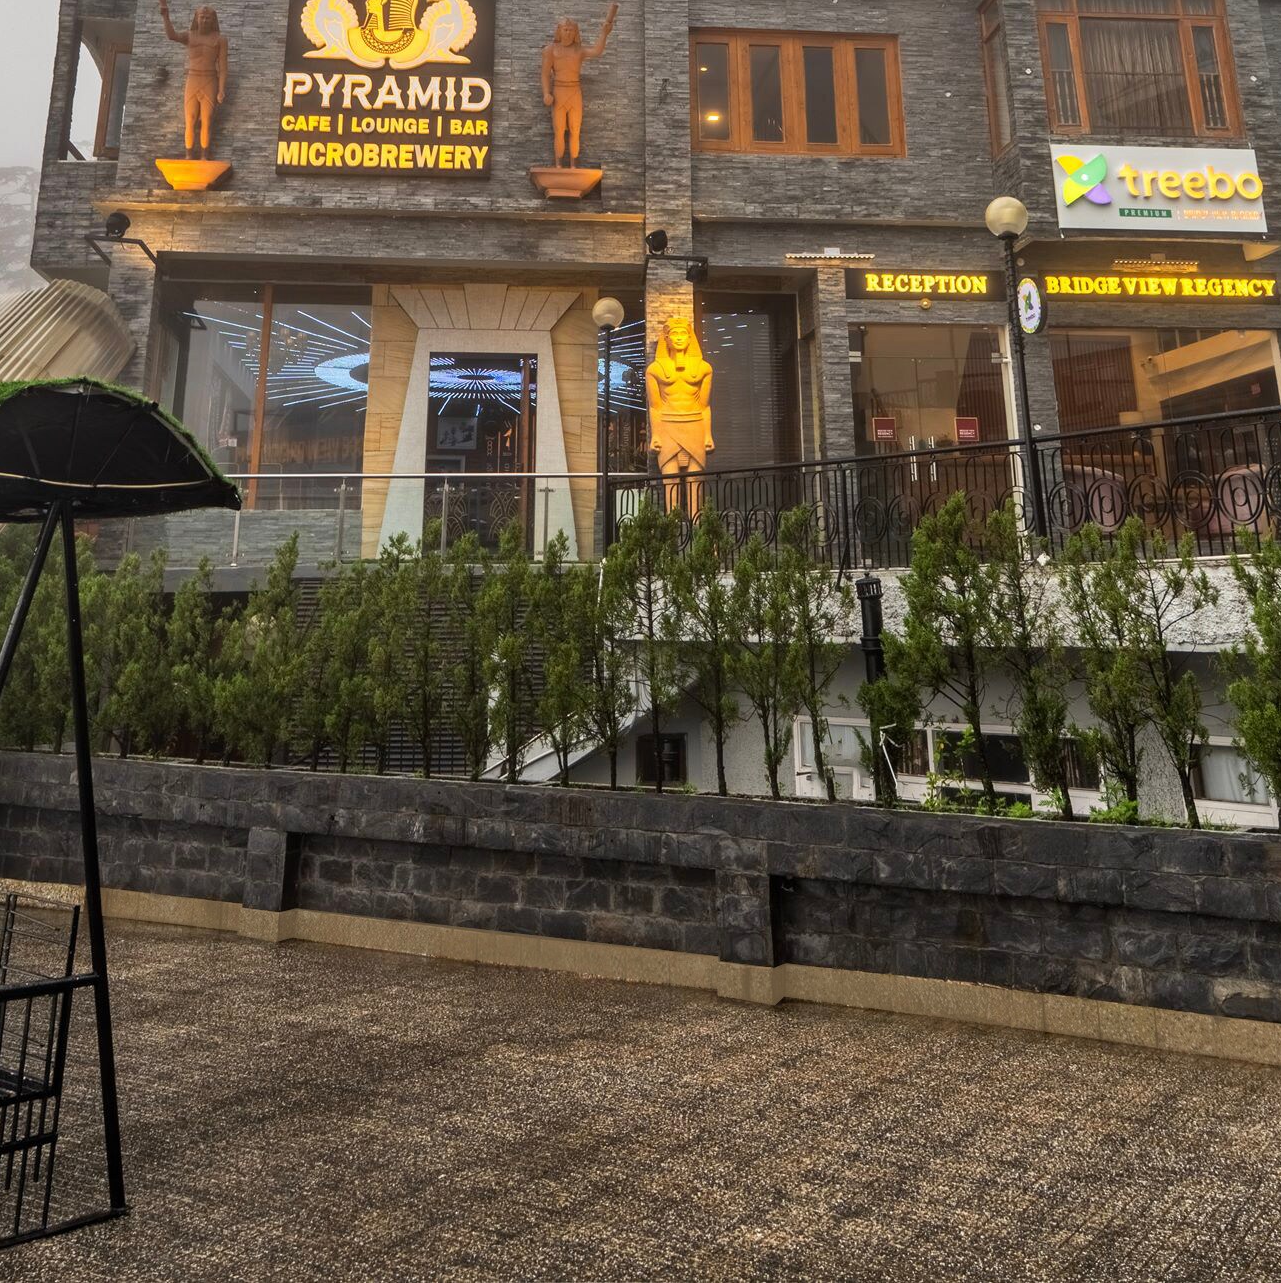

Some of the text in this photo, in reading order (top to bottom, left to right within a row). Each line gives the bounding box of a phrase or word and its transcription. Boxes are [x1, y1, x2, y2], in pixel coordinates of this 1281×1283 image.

[283, 72, 492, 112] PYRAMID
[281, 115, 488, 136] CAFE LOUNGE BAR
[276, 141, 489, 169] MICROBREWERY
[1118, 163, 1264, 200] treebo
[1124, 209, 1167, 217] PREMIUM
[865, 274, 987, 294] RECEPTION
[1045, 276, 1276, 297] BRIDGE VIEW REGENCY
